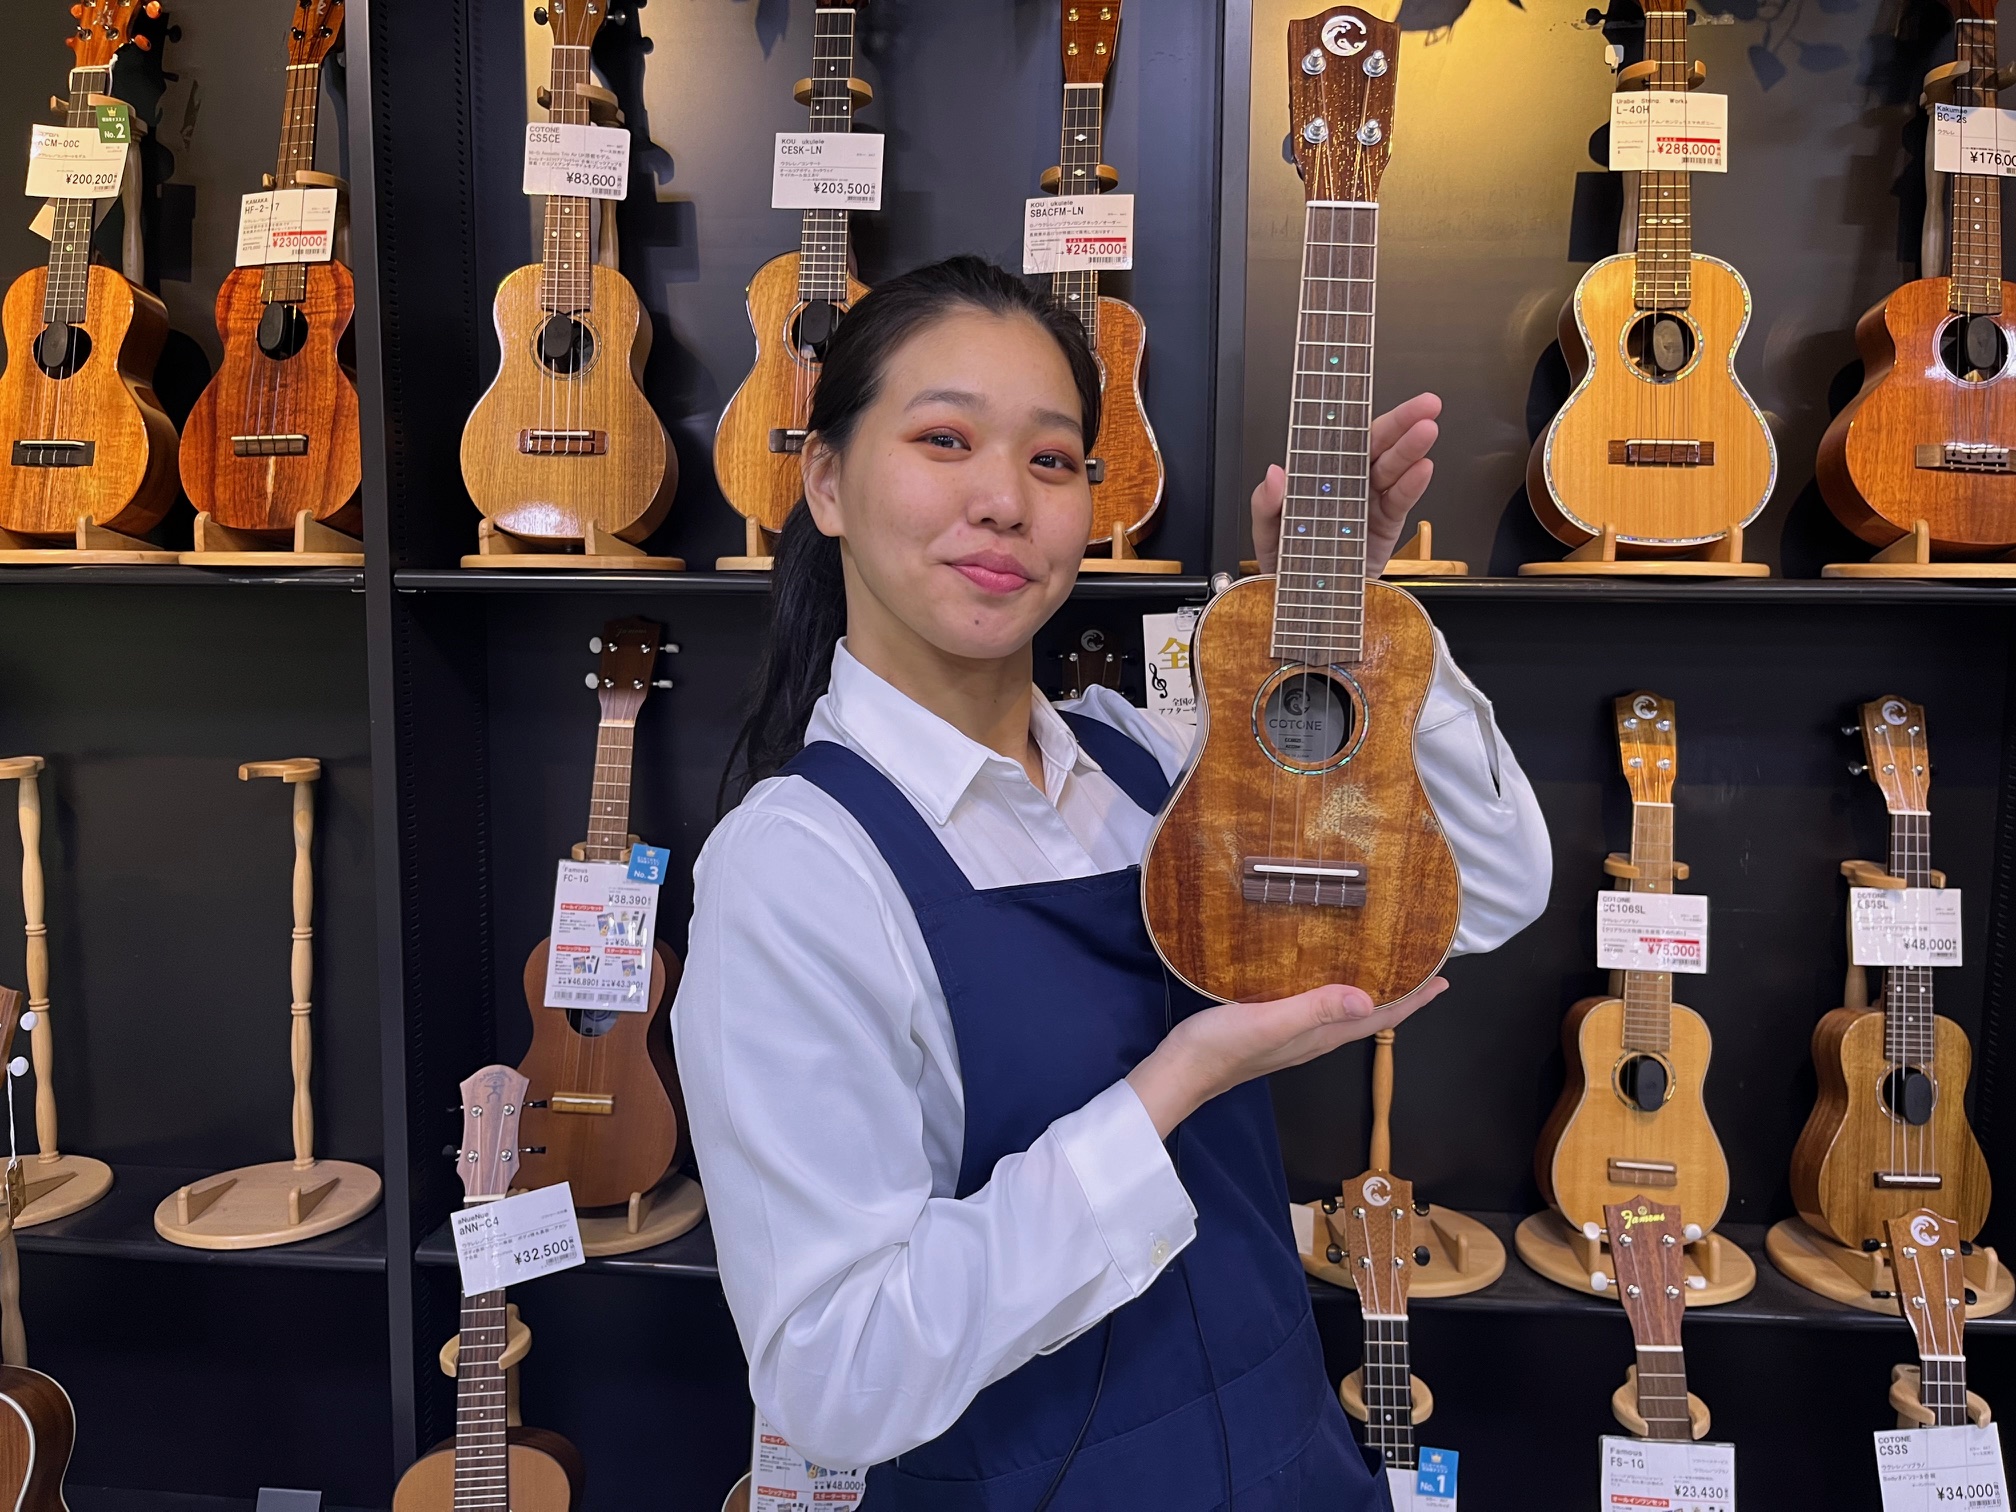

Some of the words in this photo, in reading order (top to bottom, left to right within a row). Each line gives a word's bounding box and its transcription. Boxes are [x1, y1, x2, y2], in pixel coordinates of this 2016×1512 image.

[1616, 105, 1650, 115] L-40H
[1937, 105, 1968, 114] Kakume
[530, 126, 560, 134] COTONE
[529, 134, 560, 144] CS5CE
[781, 146, 822, 155] CESK-LN
[1658, 143, 1716, 156] ¥286,000
[66, 174, 114, 185] ¥200,200
[566, 172, 616, 187] ¥83,600
[814, 182, 870, 195] ¥203,500
[1030, 206, 1084, 218] SBACFM-LN
[273, 236, 322, 248] ¥230000
[1066, 244, 1122, 256] ¥245,000
[1269, 718, 1322, 730] COTONE
[564, 874, 588, 883] FC-1G
[608, 894, 647, 905] ¥38,390
[1903, 938, 1952, 951] ¥48,000
[1648, 944, 1695, 958] ¥75,000
[458, 1212, 489, 1226] aNueNue
[1620, 1209, 1666, 1230] Famous
[460, 1216, 500, 1239] aNN-C4
[514, 1239, 569, 1266] ¥32,500
[1878, 1435, 1912, 1444] COTONE
[1610, 1447, 1642, 1457] Famous
[1880, 1444, 1908, 1456] CS3S
[1610, 1456, 1644, 1469] FS-1G
[826, 1480, 860, 1491] ¥48,000
[1674, 1485, 1724, 1499] ¥23,430
[1936, 1483, 1994, 1502] ¥34,000
[1612, 1496, 1668, 1506] オールインワンセット
